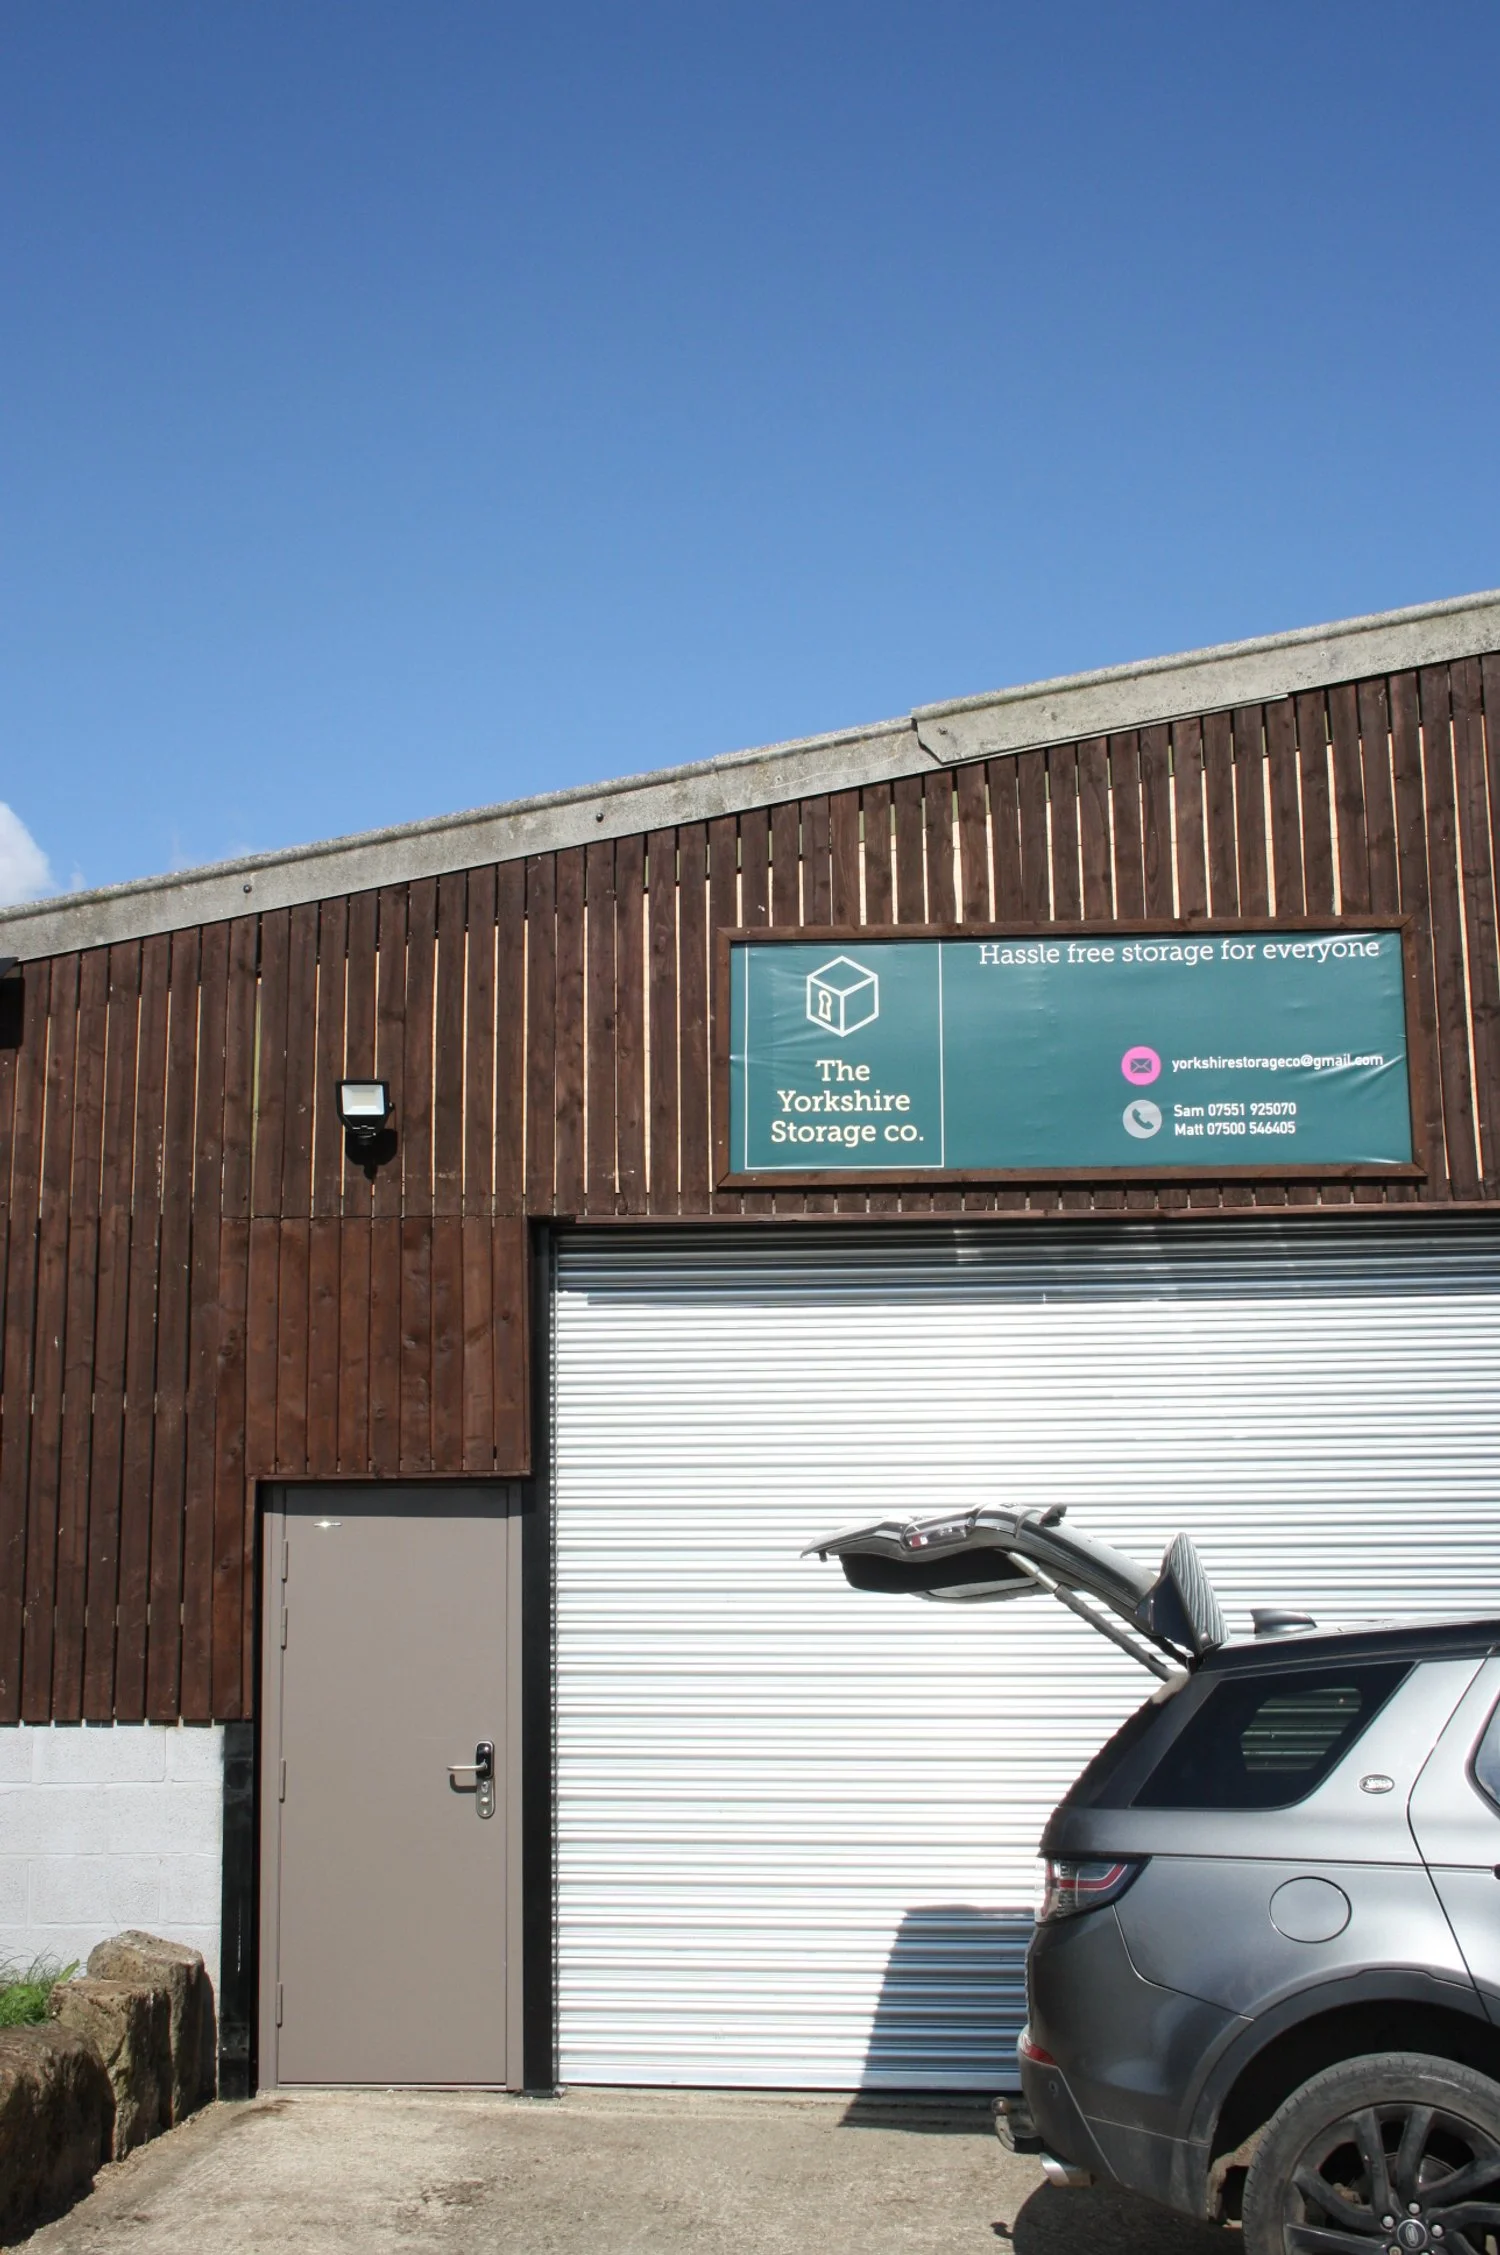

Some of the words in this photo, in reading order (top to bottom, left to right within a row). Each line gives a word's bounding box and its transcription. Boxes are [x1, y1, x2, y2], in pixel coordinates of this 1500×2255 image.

[979, 943, 1060, 965] Hassle
[1067, 942, 1115, 963] free
[1121, 941, 1214, 966] storage
[1220, 939, 1255, 960] for
[1262, 939, 1380, 963] everyone
[815, 1060, 870, 1082] The
[1171, 1053, 1384, 1073] yorkshirestorageco@gmail.com
[776, 1089, 911, 1112] Yorkshire
[1173, 1104, 1205, 1118] Sam
[1207, 1103, 1246, 1117] 07551
[1249, 1102, 1297, 1116] 925070
[771, 1120, 876, 1148] Storage
[884, 1124, 924, 1142] co.
[1174, 1123, 1205, 1136] Matt
[1206, 1122, 1246, 1135] 07500
[1249, 1121, 1296, 1134] 546405
